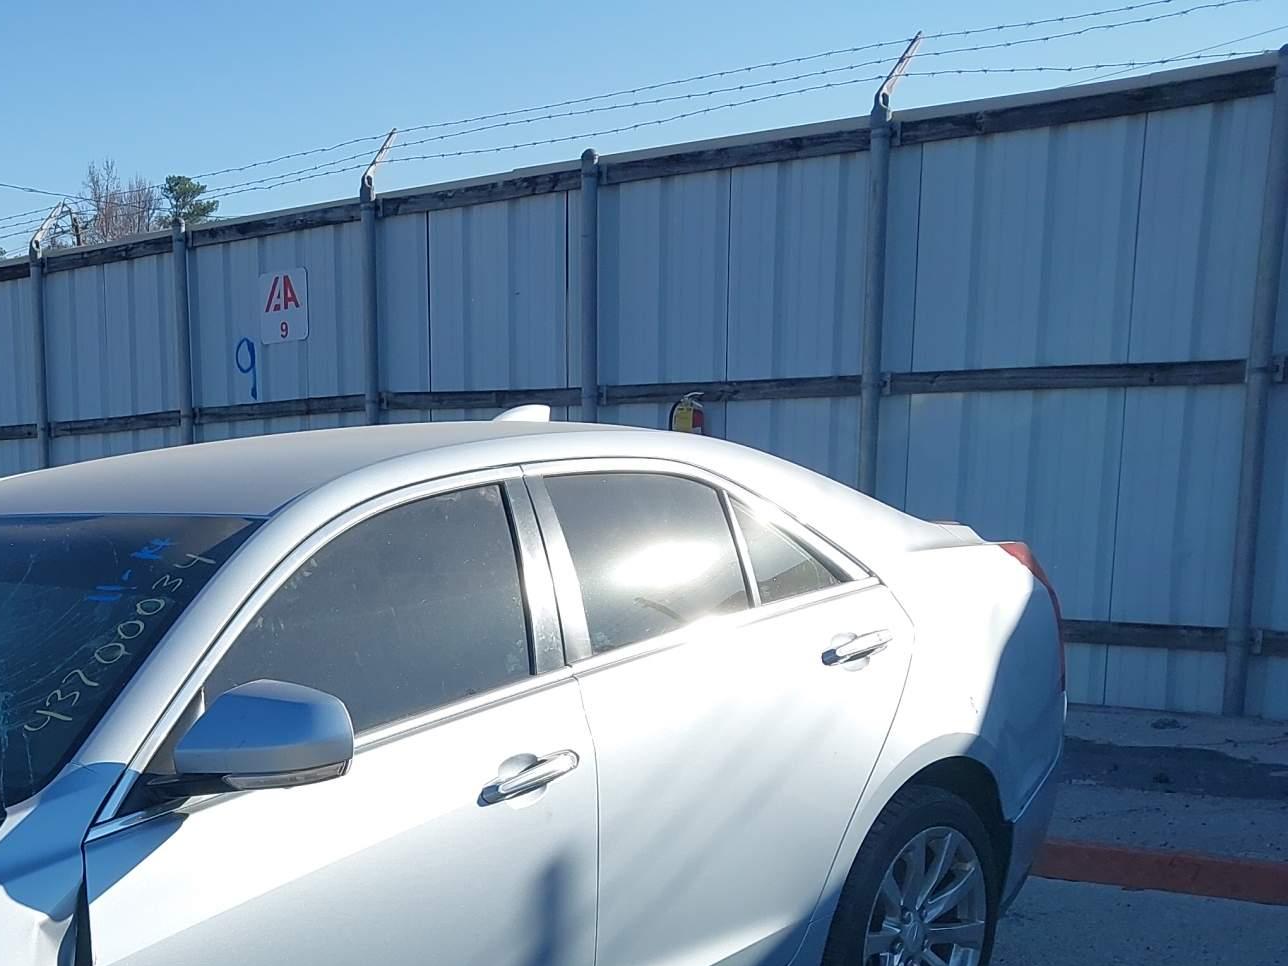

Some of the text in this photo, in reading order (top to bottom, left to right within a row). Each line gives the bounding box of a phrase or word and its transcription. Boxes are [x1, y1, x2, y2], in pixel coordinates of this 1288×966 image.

[280, 321, 289, 339] 9
[235, 337, 258, 400] 9
[23, 553, 216, 732] 43700034
